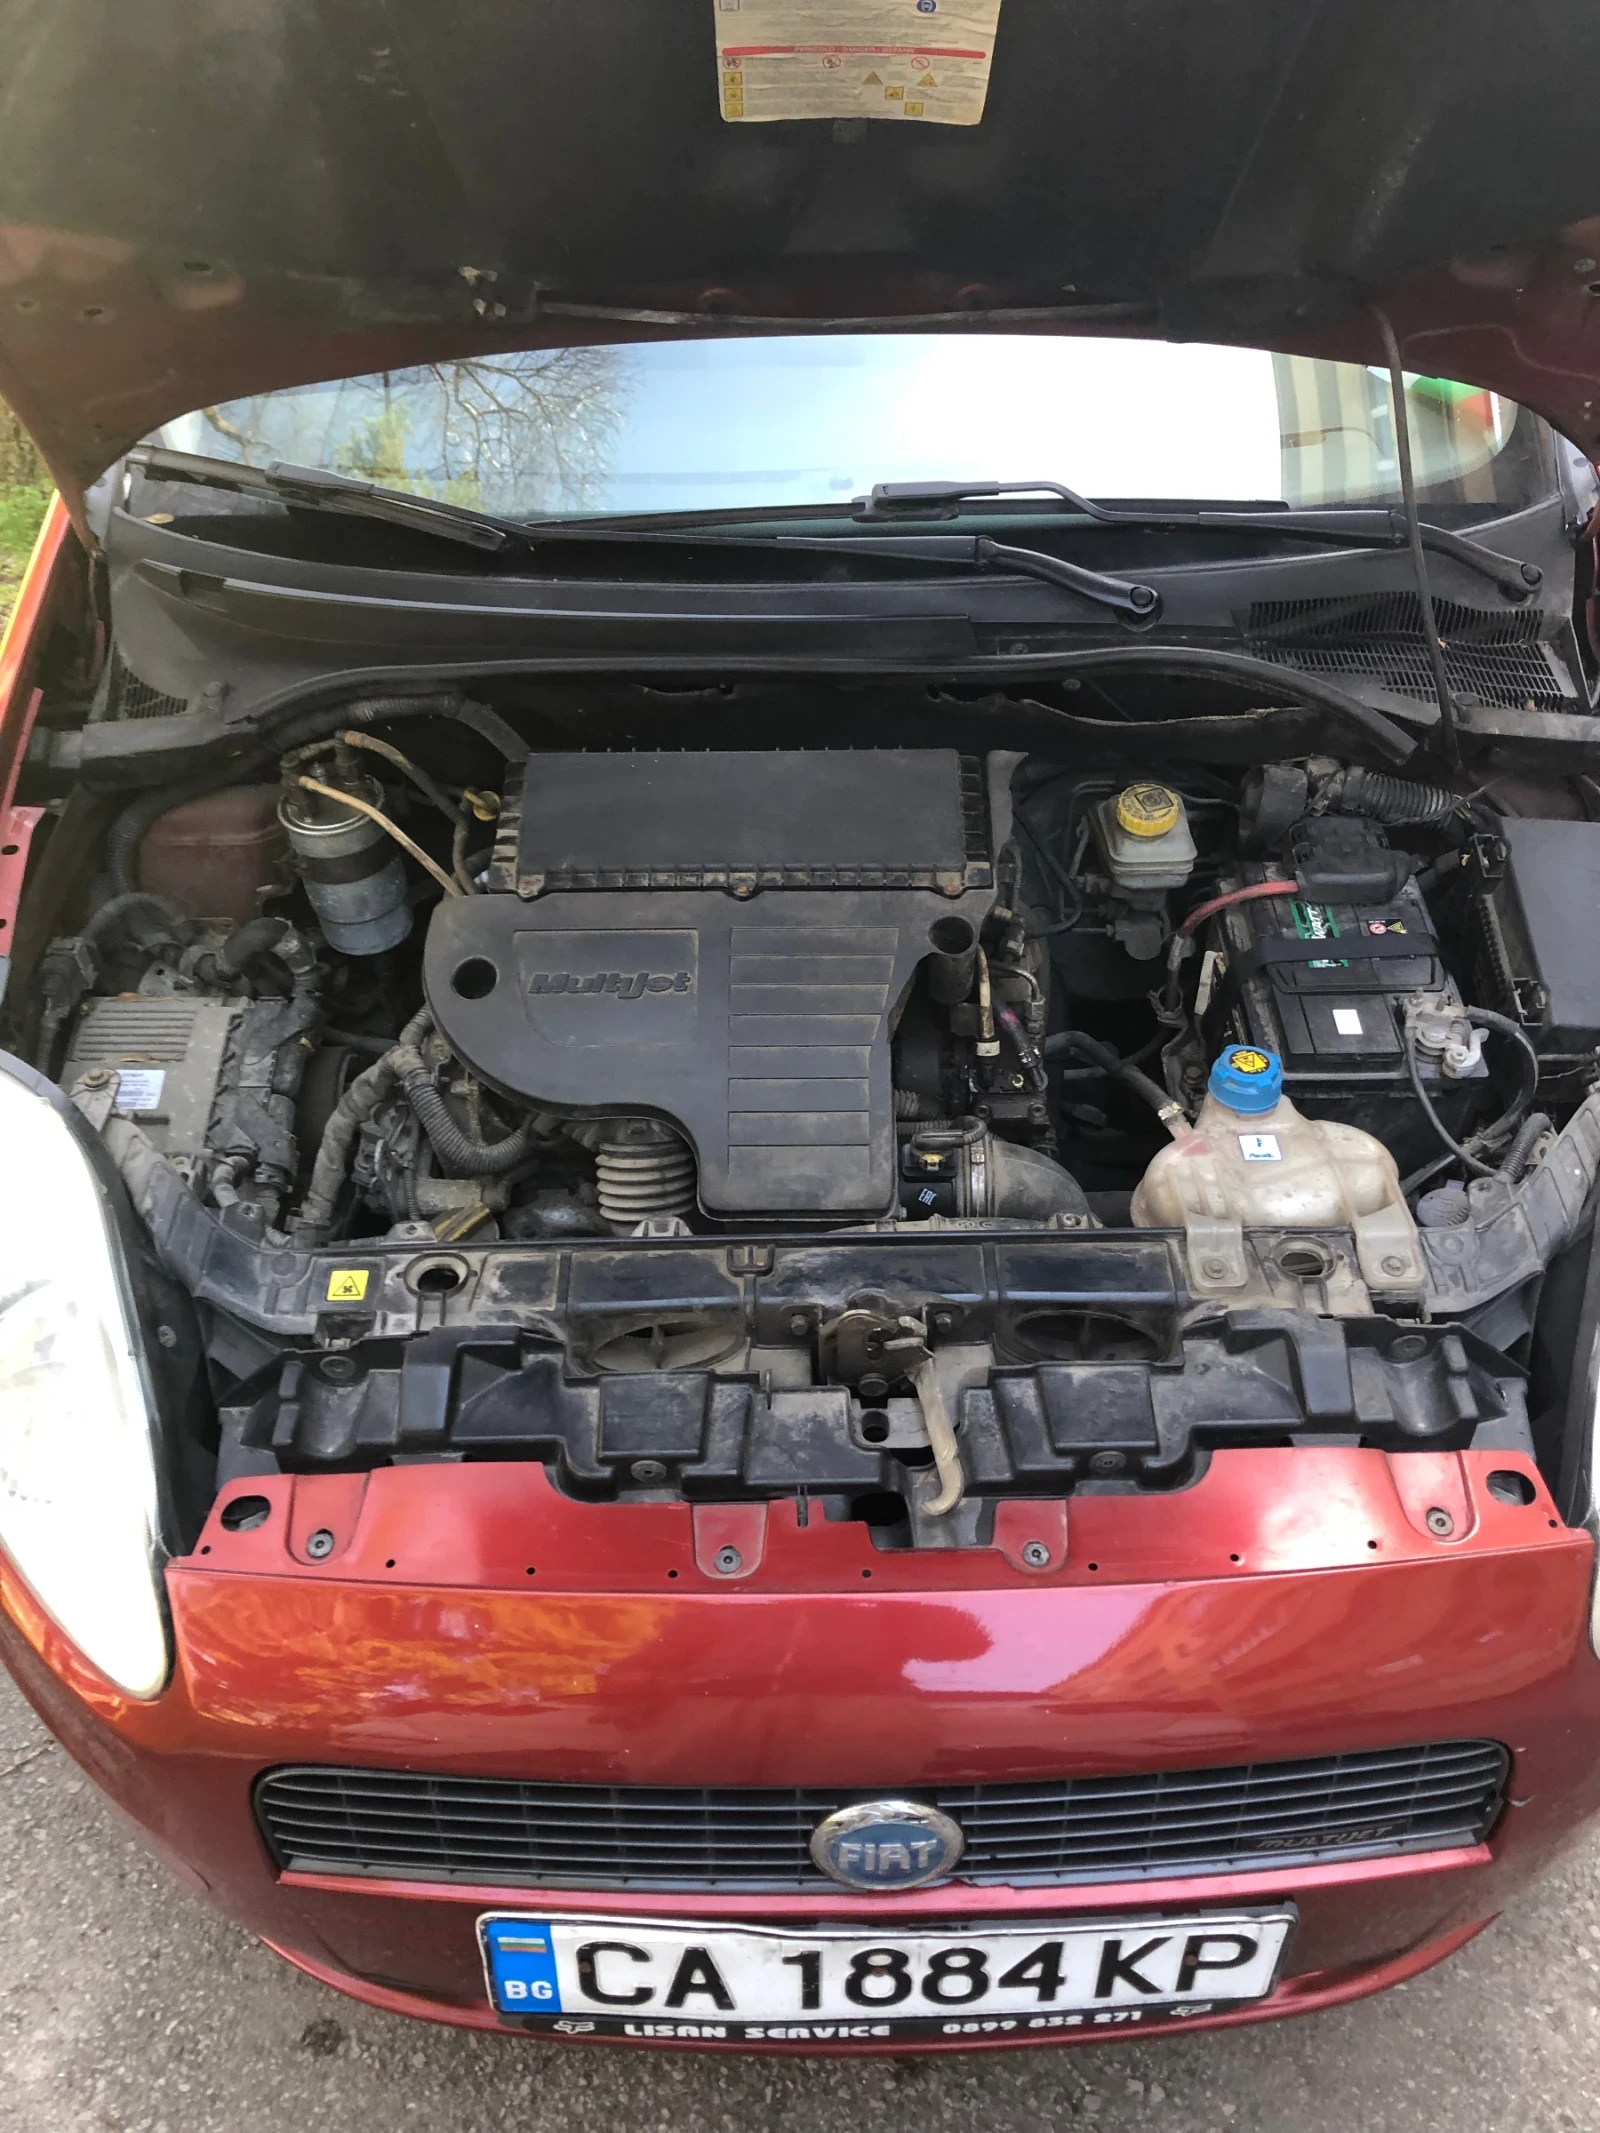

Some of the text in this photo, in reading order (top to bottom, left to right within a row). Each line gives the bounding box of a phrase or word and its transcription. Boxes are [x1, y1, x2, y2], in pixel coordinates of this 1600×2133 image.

[918, 1187, 937, 1206] EAC
[838, 1839, 938, 1872] FIAT
[575, 1933, 1259, 2011] CA 1884 KP
[504, 1980, 553, 1999] BG
[624, 2022, 727, 2039] LISAN
[743, 2024, 891, 2040] SERVICE
[942, 2019, 1018, 2035] 0899
[1093, 2010, 1143, 2025] 271
